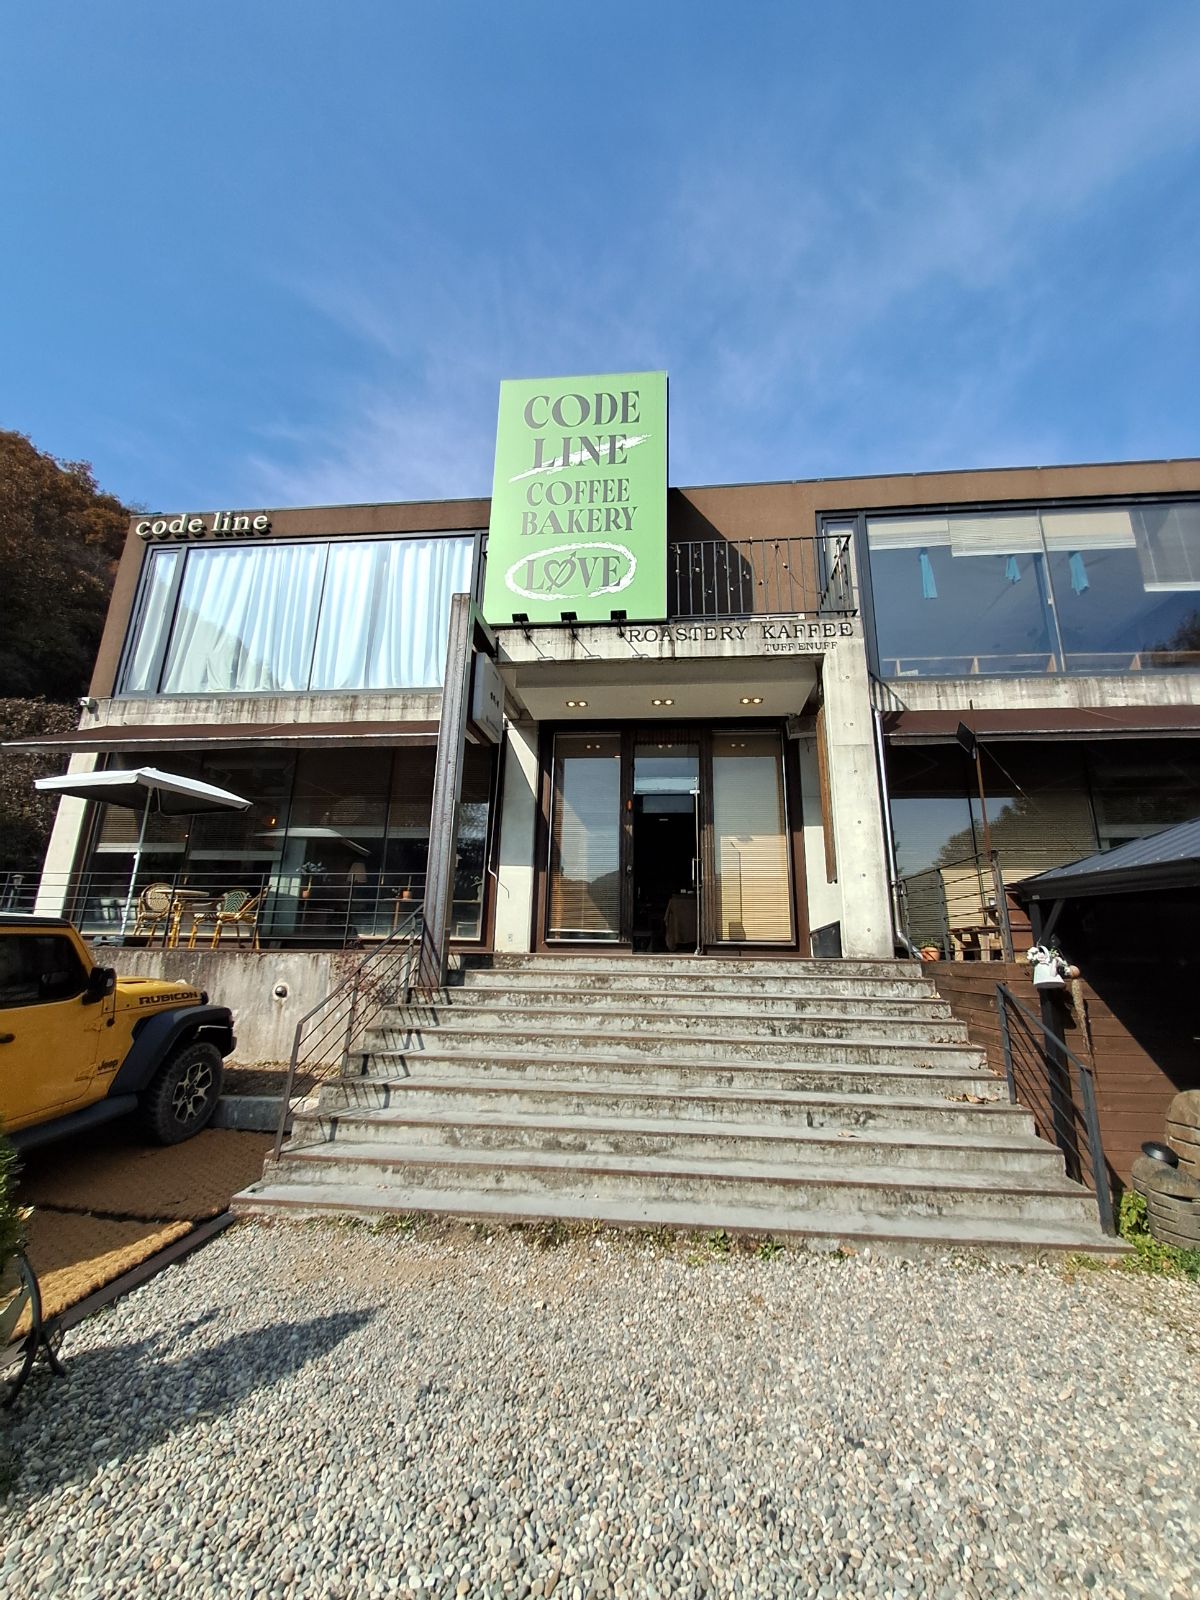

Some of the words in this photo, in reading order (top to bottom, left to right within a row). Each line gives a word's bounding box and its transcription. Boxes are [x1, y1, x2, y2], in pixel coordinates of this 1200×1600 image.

[523, 390, 641, 430] CODE
[532, 433, 629, 469] LINE
[526, 478, 630, 507] COFFEE
[135, 513, 204, 538] code
[211, 511, 269, 534] line
[520, 506, 638, 536] BAKERY
[627, 625, 748, 643] ROASTERY
[761, 622, 854, 640] KAFFEE
[765, 642, 796, 652] TUFF
[797, 641, 838, 652] ENUFF
[138, 990, 198, 1006] RUBICON
[97, 1058, 119, 1071] Jeep
